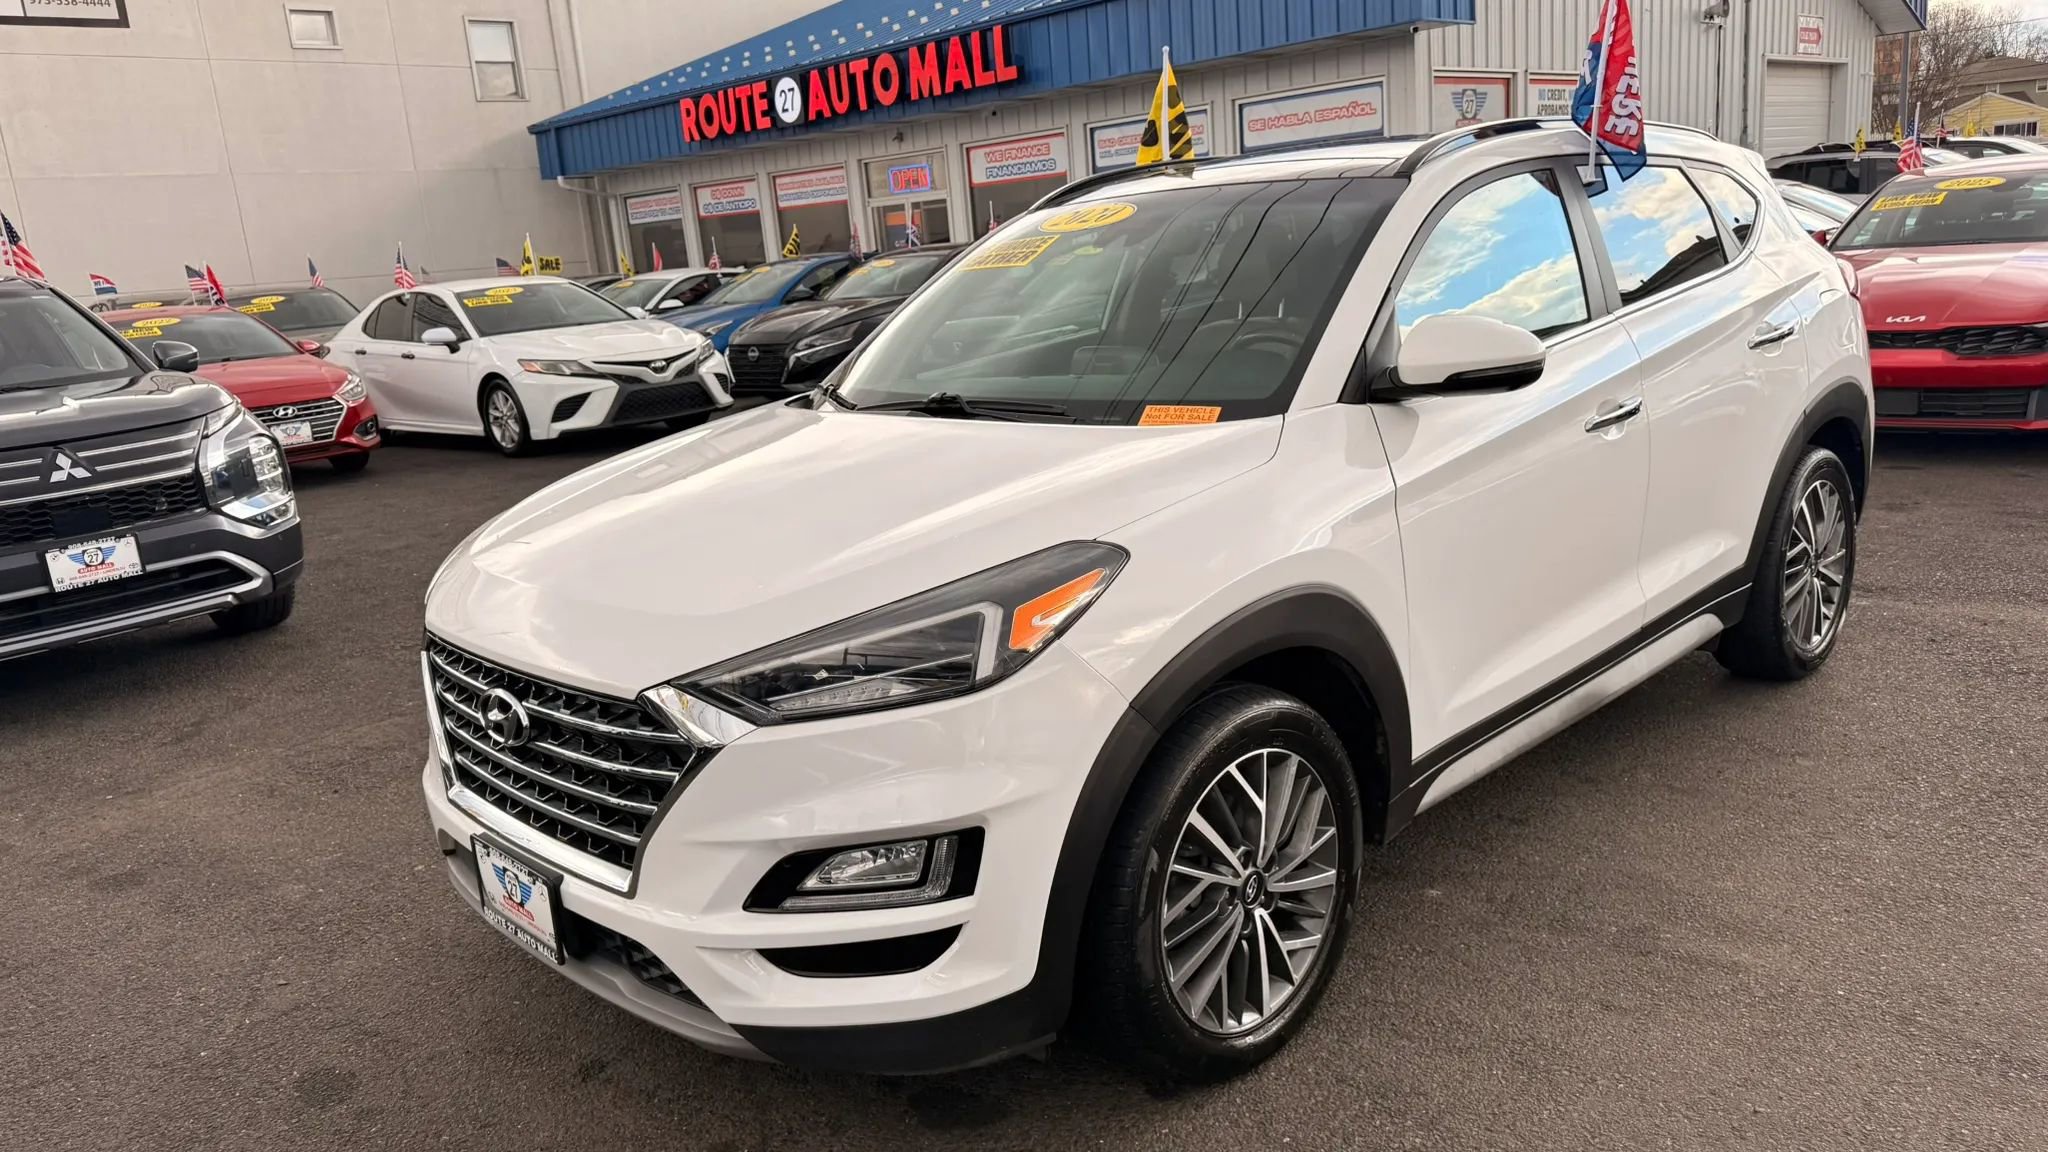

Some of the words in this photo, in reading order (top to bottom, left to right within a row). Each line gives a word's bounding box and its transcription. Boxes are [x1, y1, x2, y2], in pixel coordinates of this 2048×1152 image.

[680, 80, 772, 142] ROUTE
[779, 87, 796, 113] 27
[808, 53, 899, 120] AUTO
[909, 25, 1018, 100] MALL
[1248, 118, 1266, 132] SE
[1267, 112, 1312, 129] HABLA
[1314, 100, 1377, 123] ESPAÑOL
[1464, 99, 1475, 114] 27
[985, 149, 1004, 163] WE
[1005, 143, 1051, 161] FINANCE
[986, 158, 1056, 179] FINANCIAMOS
[891, 167, 929, 192] OPEN
[539, 257, 561, 271] SALE
[1173, 406, 1217, 414] VEHICLE
[1186, 413, 1216, 422] SALE
[80, 566, 97, 574] AUTO
[97, 562, 114, 570] MALL
[87, 553, 99, 564] 27
[55, 581, 82, 592] ROUTE
[98, 573, 119, 583] AUTO
[121, 569, 144, 578] MALL
[508, 879, 518, 900] 27
[484, 906, 507, 929] ROUTE
[506, 922, 516, 935] 27
[517, 928, 536, 950] AUTO
[536, 943, 559, 964] MALL
